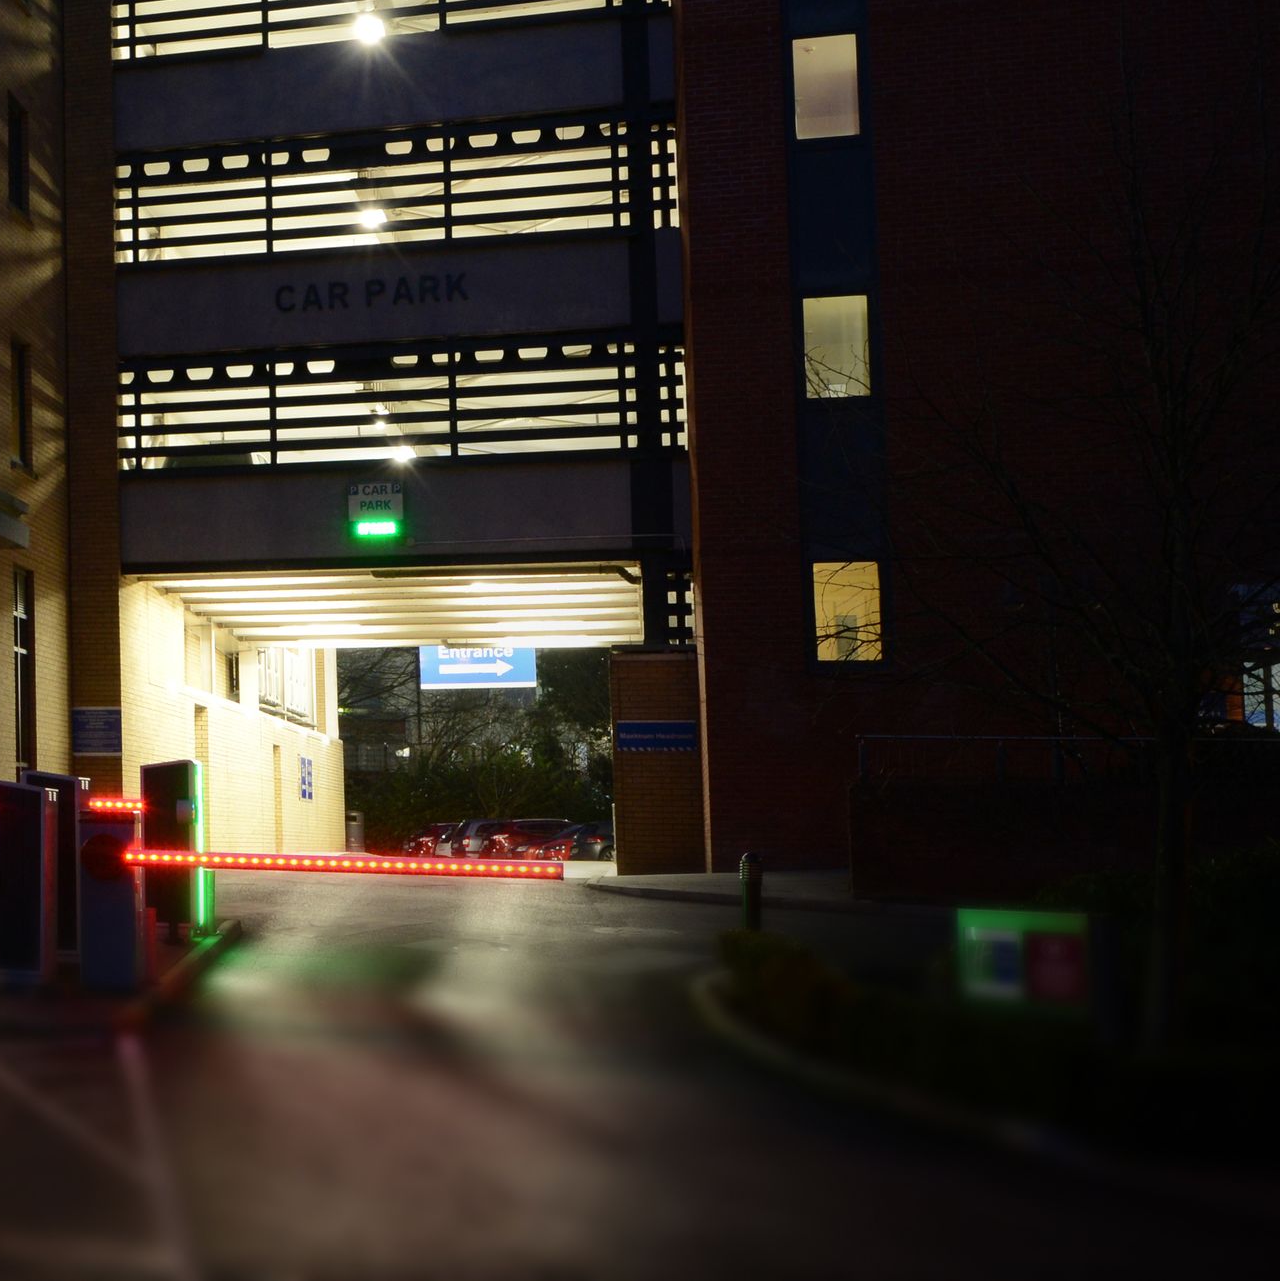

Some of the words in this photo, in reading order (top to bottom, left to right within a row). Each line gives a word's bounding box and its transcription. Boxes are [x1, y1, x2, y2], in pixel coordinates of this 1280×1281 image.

[275, 282, 350, 312] CAR
[364, 272, 470, 308] PARK
[362, 485, 388, 496] CAR
[360, 500, 392, 511] PARK
[438, 645, 514, 659] Entrance
